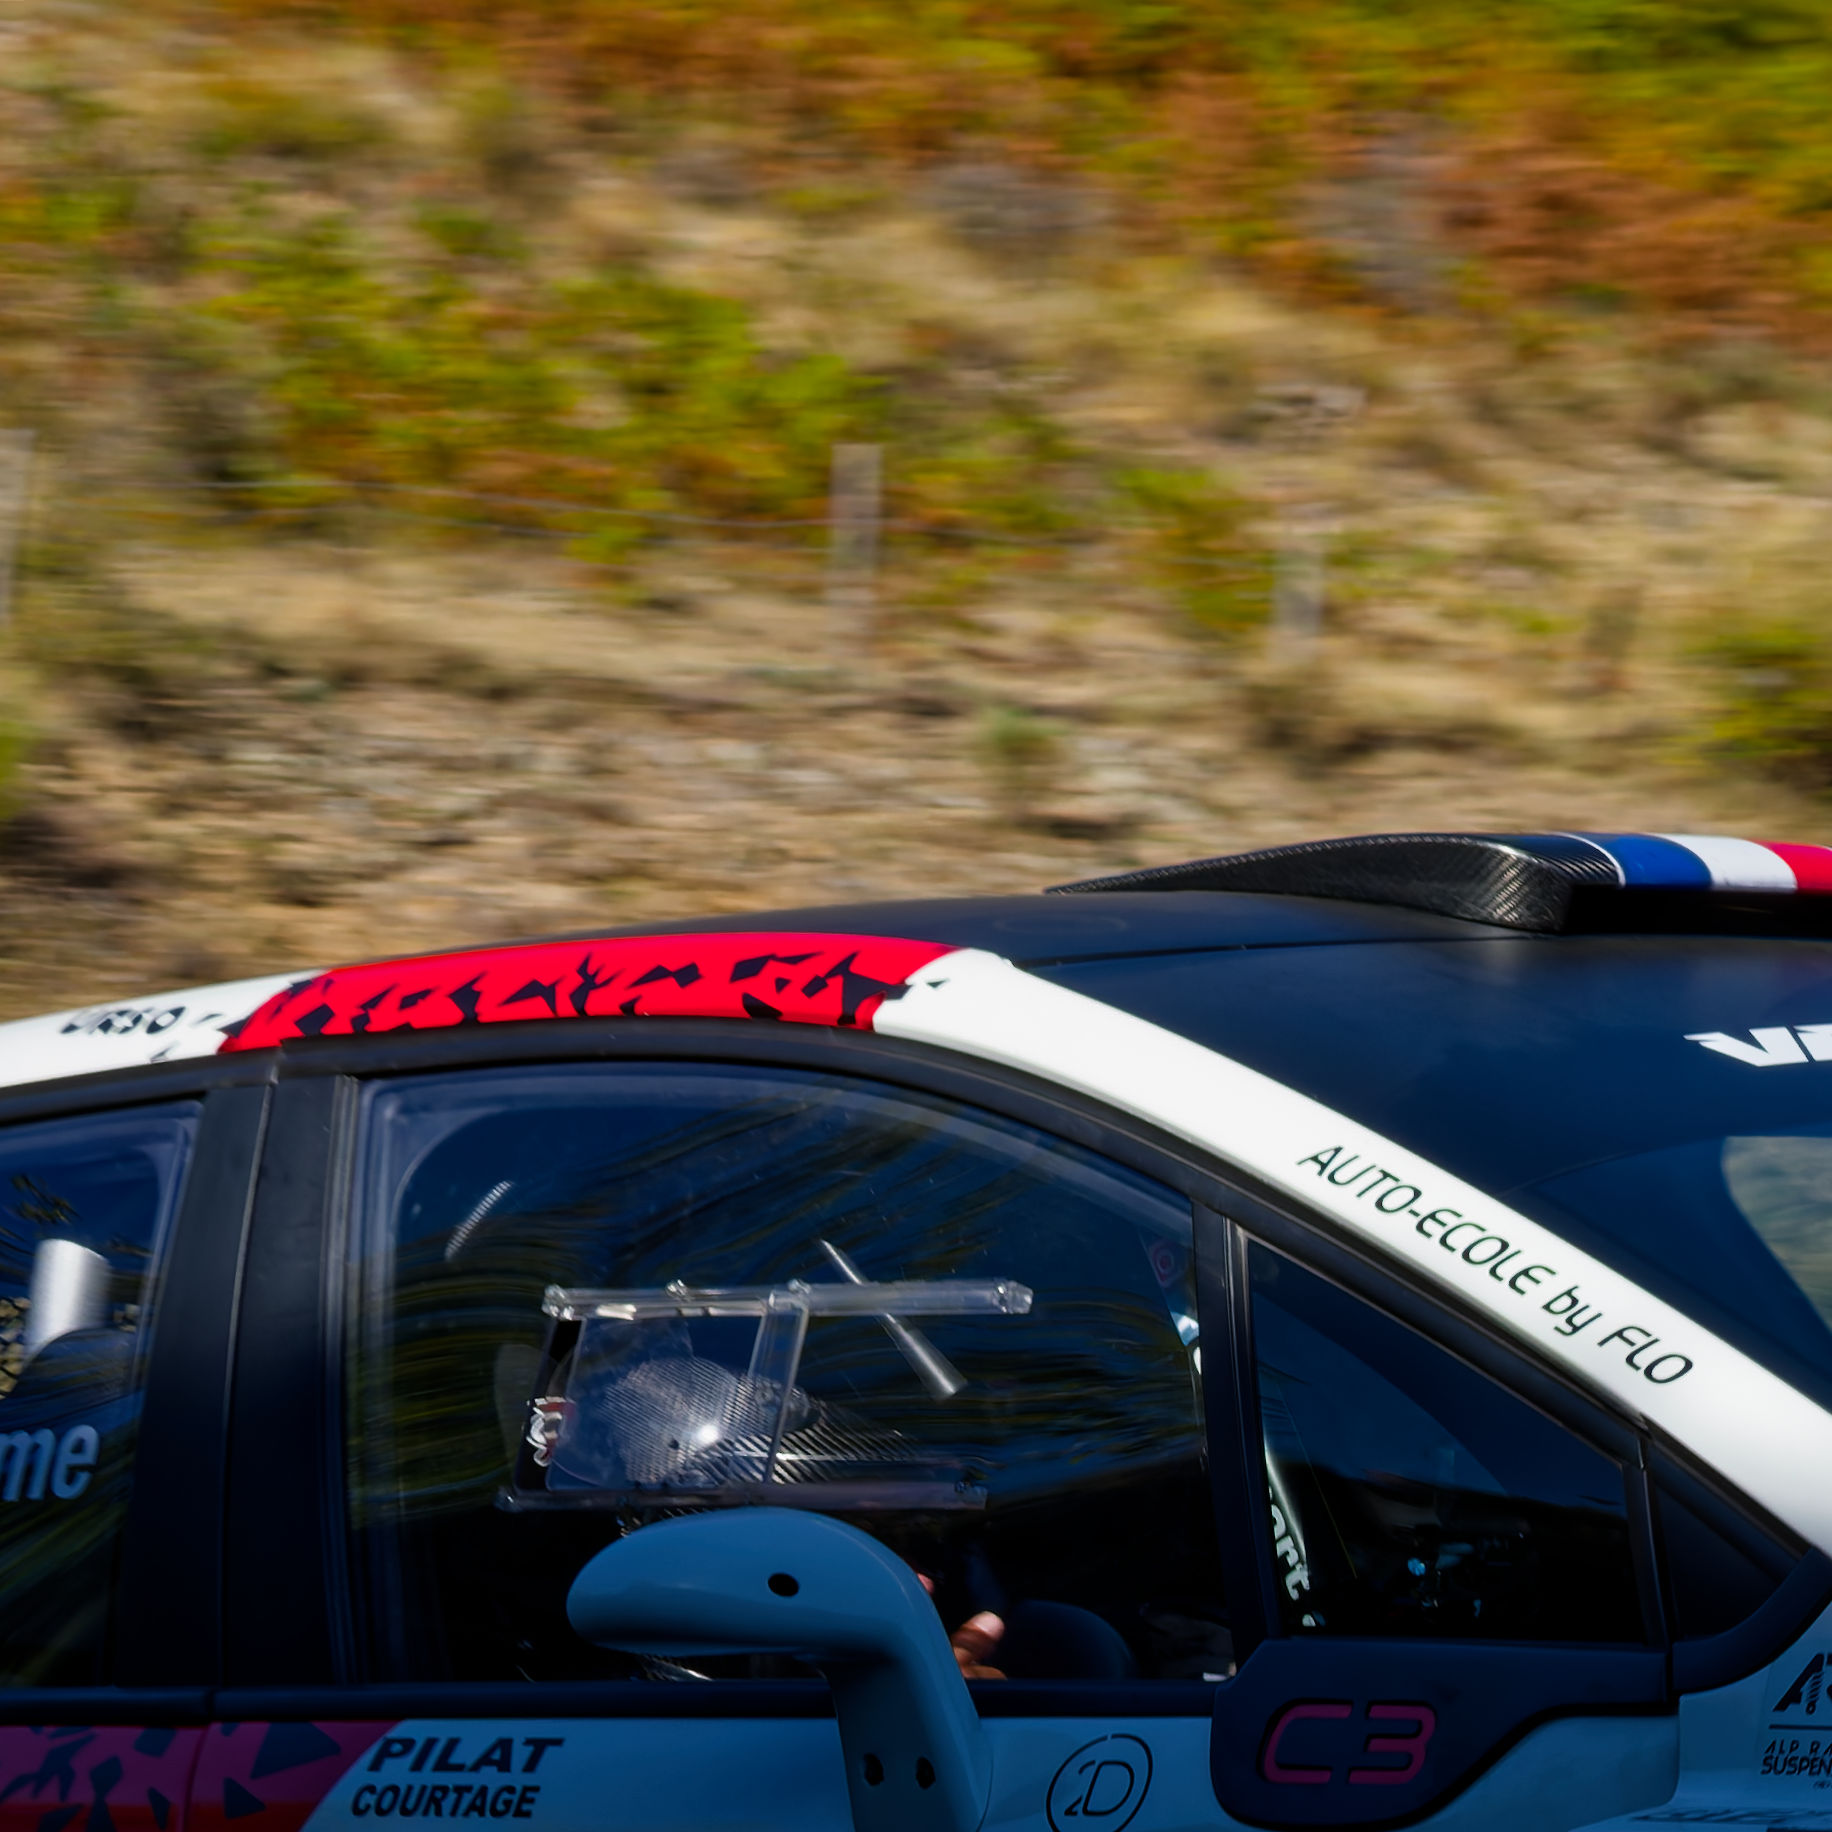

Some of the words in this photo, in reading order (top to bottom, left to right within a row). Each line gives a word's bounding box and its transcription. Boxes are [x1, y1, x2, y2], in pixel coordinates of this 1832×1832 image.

[1297, 1145, 1557, 1295] AUTO-ECOLE
[1542, 1285, 1602, 1336] by
[1597, 1326, 1694, 1384] FLO
[368, 1737, 566, 1772] PILAT
[1258, 1700, 1437, 1785] C3
[1764, 1740, 1799, 1755] ALP
[352, 1784, 540, 1818] COURTAGE
